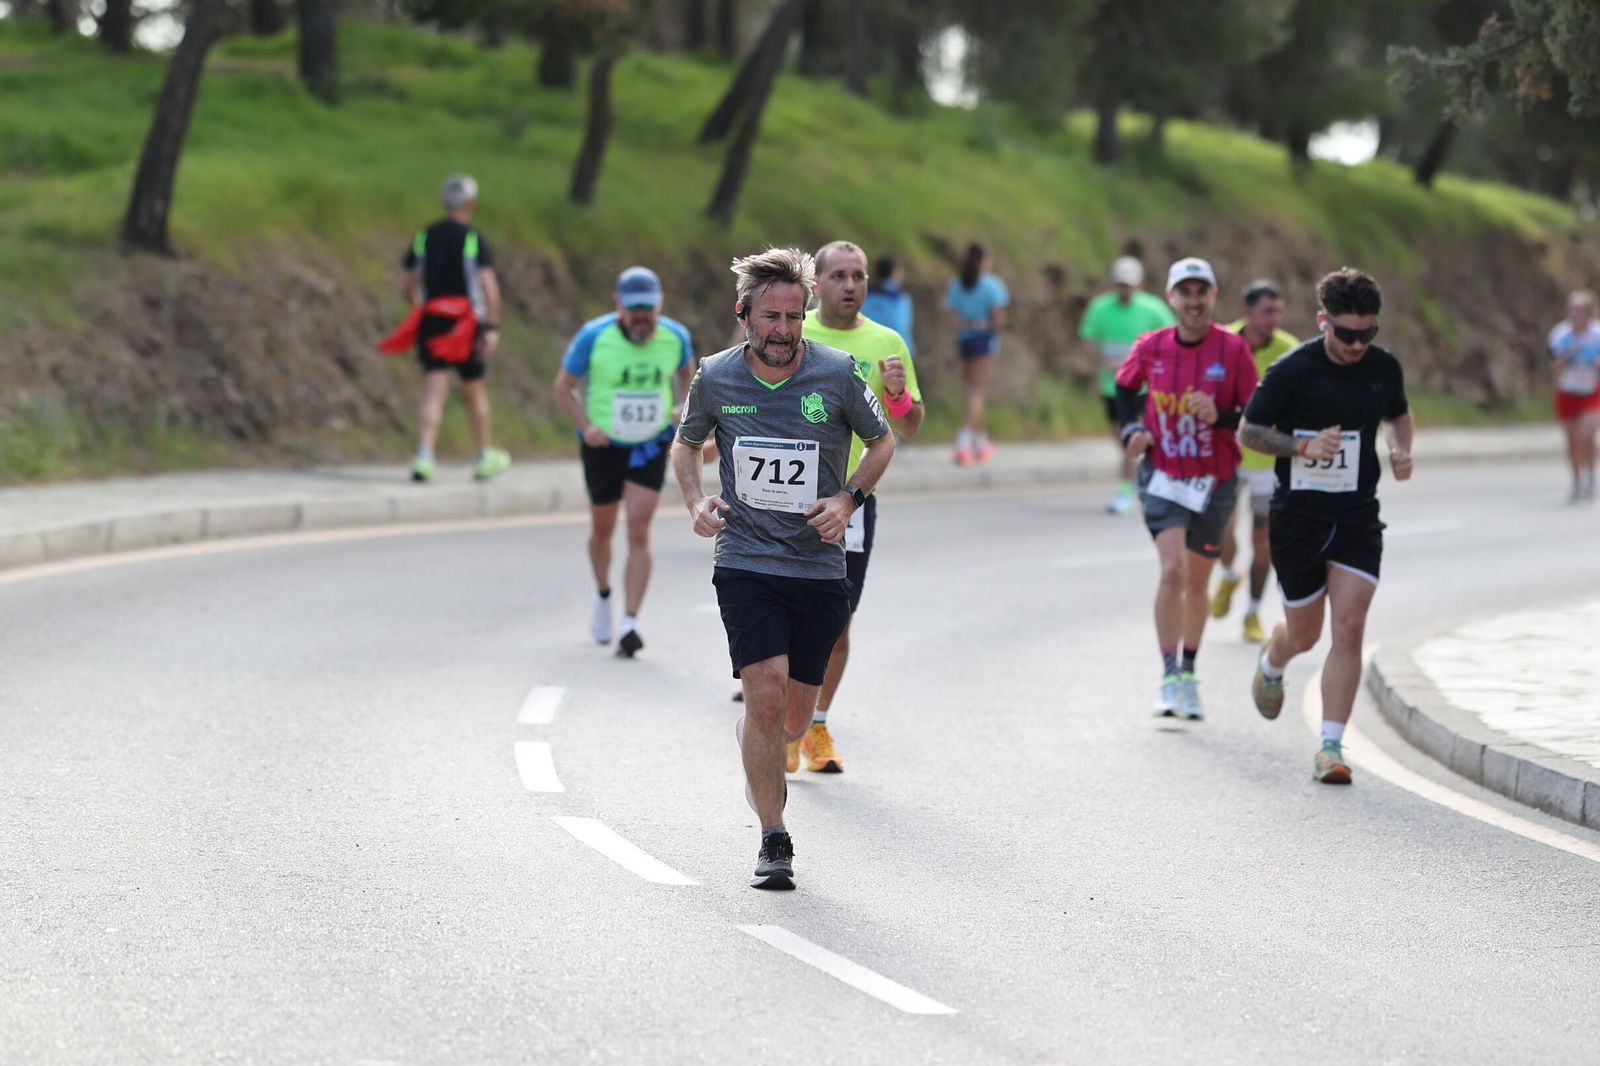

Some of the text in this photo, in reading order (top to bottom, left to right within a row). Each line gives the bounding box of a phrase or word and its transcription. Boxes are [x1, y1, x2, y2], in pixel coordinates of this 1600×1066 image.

[620, 404, 657, 422] 612
[721, 405, 757, 414] macron
[748, 456, 806, 486] 712
